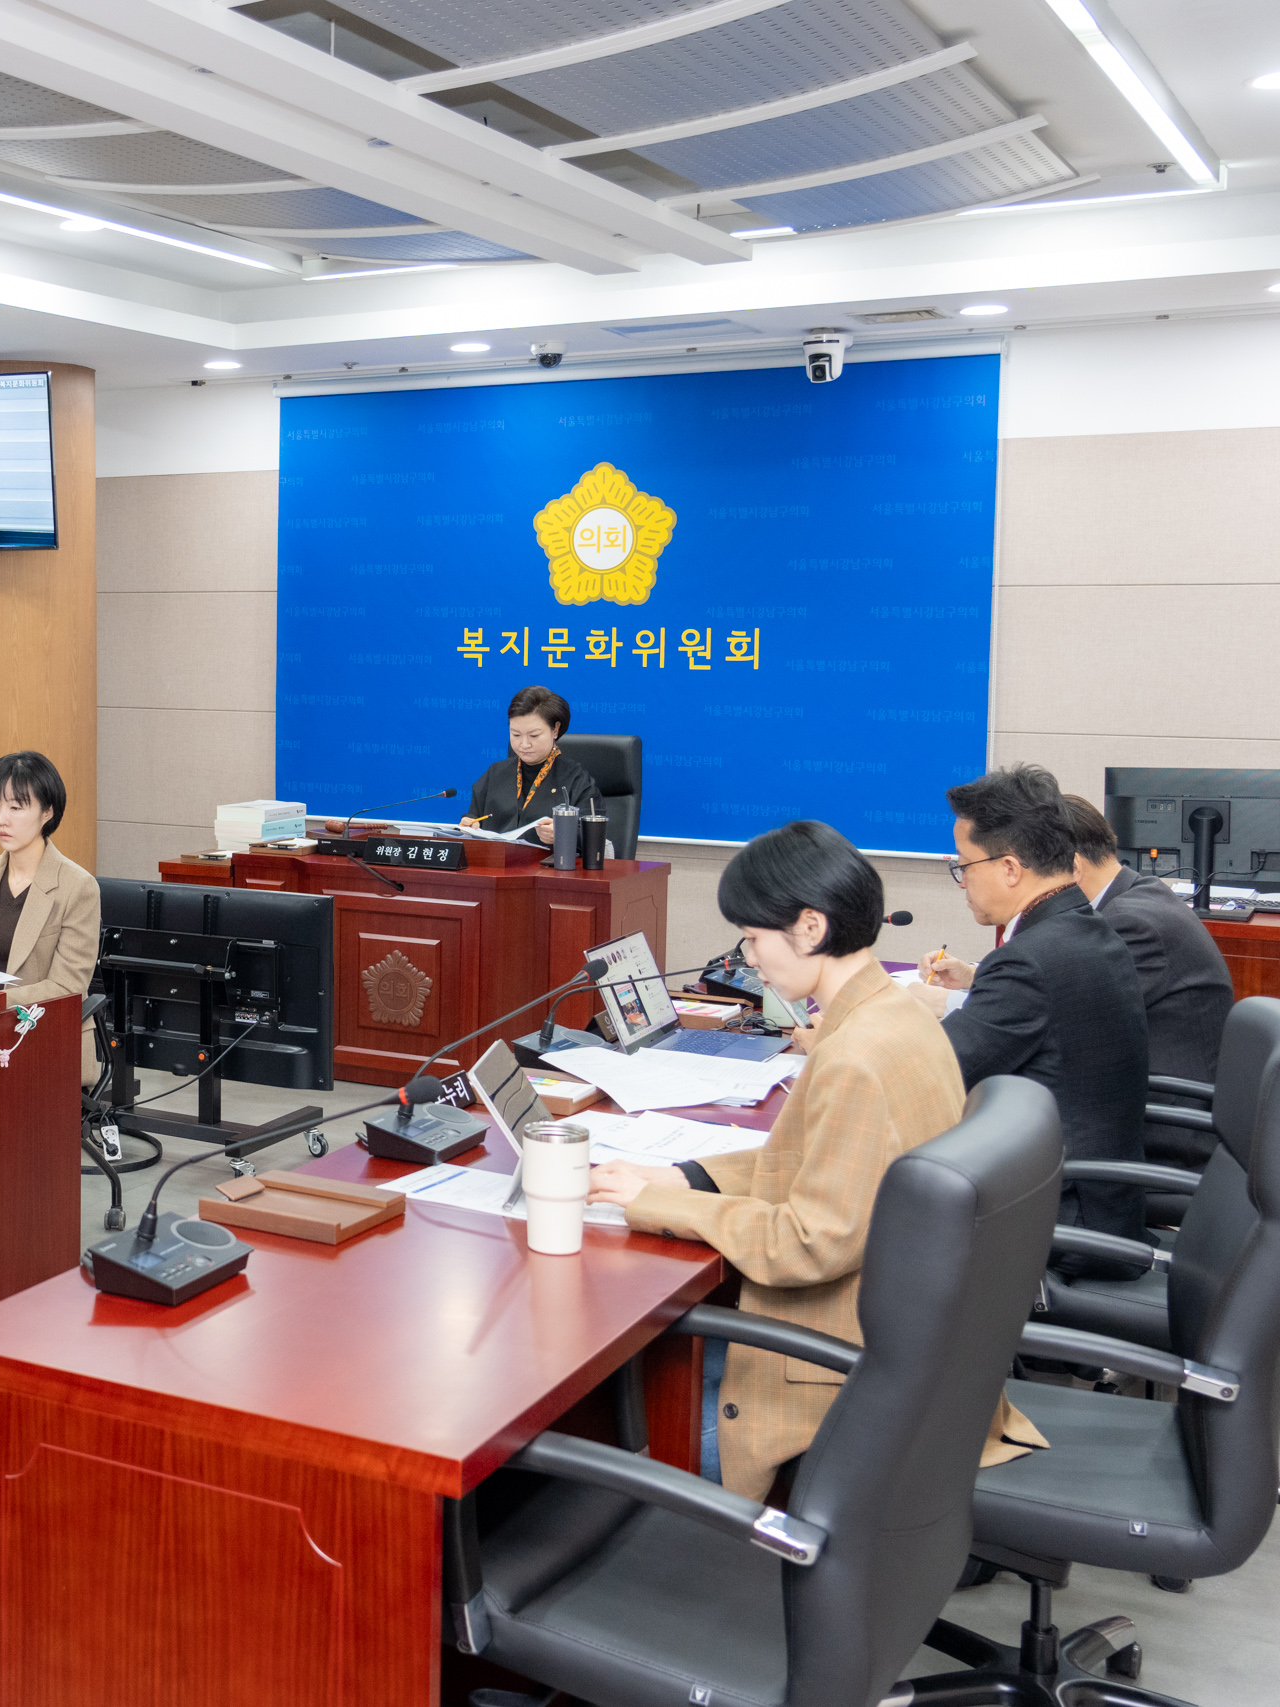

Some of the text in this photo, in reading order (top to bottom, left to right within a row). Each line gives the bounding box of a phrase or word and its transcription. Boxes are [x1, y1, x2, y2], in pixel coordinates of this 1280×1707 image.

[0, 379, 44, 388] 복지문화위원회
[875, 394, 987, 412] 서울특별시강남구의회
[710, 403, 812, 420] 서울특별시강남구의회
[417, 419, 506, 435] 서울특별시강남구의회
[558, 412, 653, 428] 서울특별시강남구의회
[286, 426, 368, 440] 서울특별시강남구의회
[790, 454, 897, 470] 서울특별시강남구의회
[351, 472, 435, 485] 서울특별시강남구의회
[708, 506, 810, 520] 서울특별시강남구의회
[873, 500, 983, 516] 서울특별시강남구의회
[286, 516, 367, 529] 서울특별시강남구의회
[417, 514, 504, 529] 서울특별시강남구의회
[578, 525, 627, 553] 의회
[350, 564, 434, 576] 서울특별시강남구의회
[787, 557, 893, 571] 서울특별시강남구의회
[285, 607, 366, 617] 서울특별시강남구의회
[414, 607, 502, 618] 서울특별시강남구의회
[705, 606, 807, 619] 서울특별시강남구의회
[870, 606, 979, 619] 서울특별시강남구의회
[456, 626, 761, 671] 복지문화위원회
[348, 653, 432, 665] 서울특별시강남구의회
[785, 659, 890, 673] 서울특별시강남구의회
[284, 694, 365, 707] 서울특별시강남구의회
[413, 697, 500, 711] 서울특별시강남구의회
[703, 704, 804, 719] 서울특별시강남구의회
[867, 708, 975, 722] 서울특별시강남구의회
[348, 741, 431, 755] 서울특별시강남구의회
[781, 760, 887, 775] 서울특별시강남구의회
[283, 782, 362, 796] 서울특별시강남구의회
[701, 802, 801, 816] 서울특별시강남구의회
[375, 841, 449, 861] 위원장 김현정
[380, 981, 411, 1001] 의회
